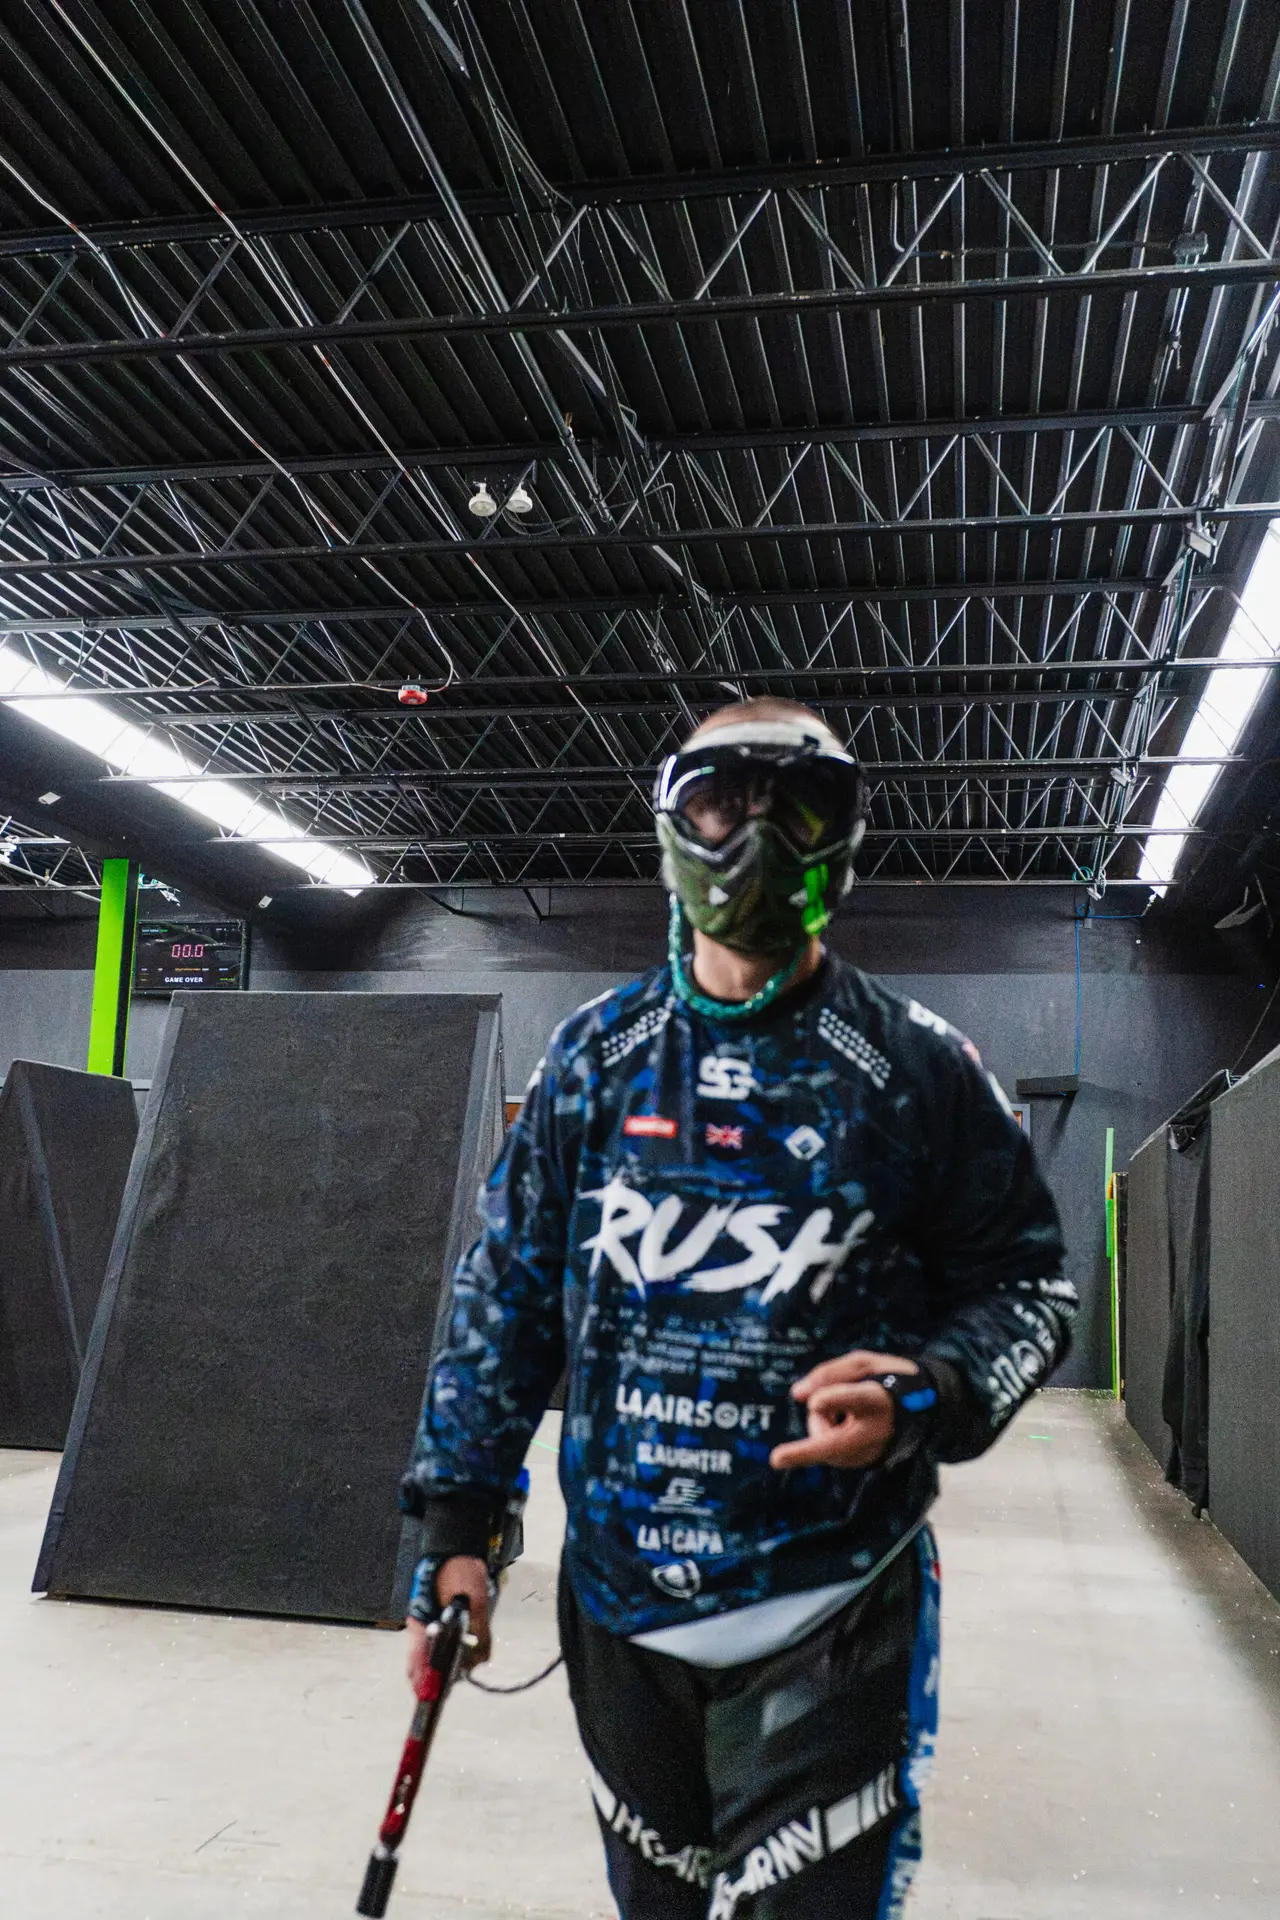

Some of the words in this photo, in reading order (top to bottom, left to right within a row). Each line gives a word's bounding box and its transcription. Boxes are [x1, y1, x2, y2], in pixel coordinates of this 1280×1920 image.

[171, 943, 204, 958] 00.0
[164, 976, 184, 984] GAME
[185, 976, 204, 984] OVER
[580, 1178, 875, 1304] RUSH
